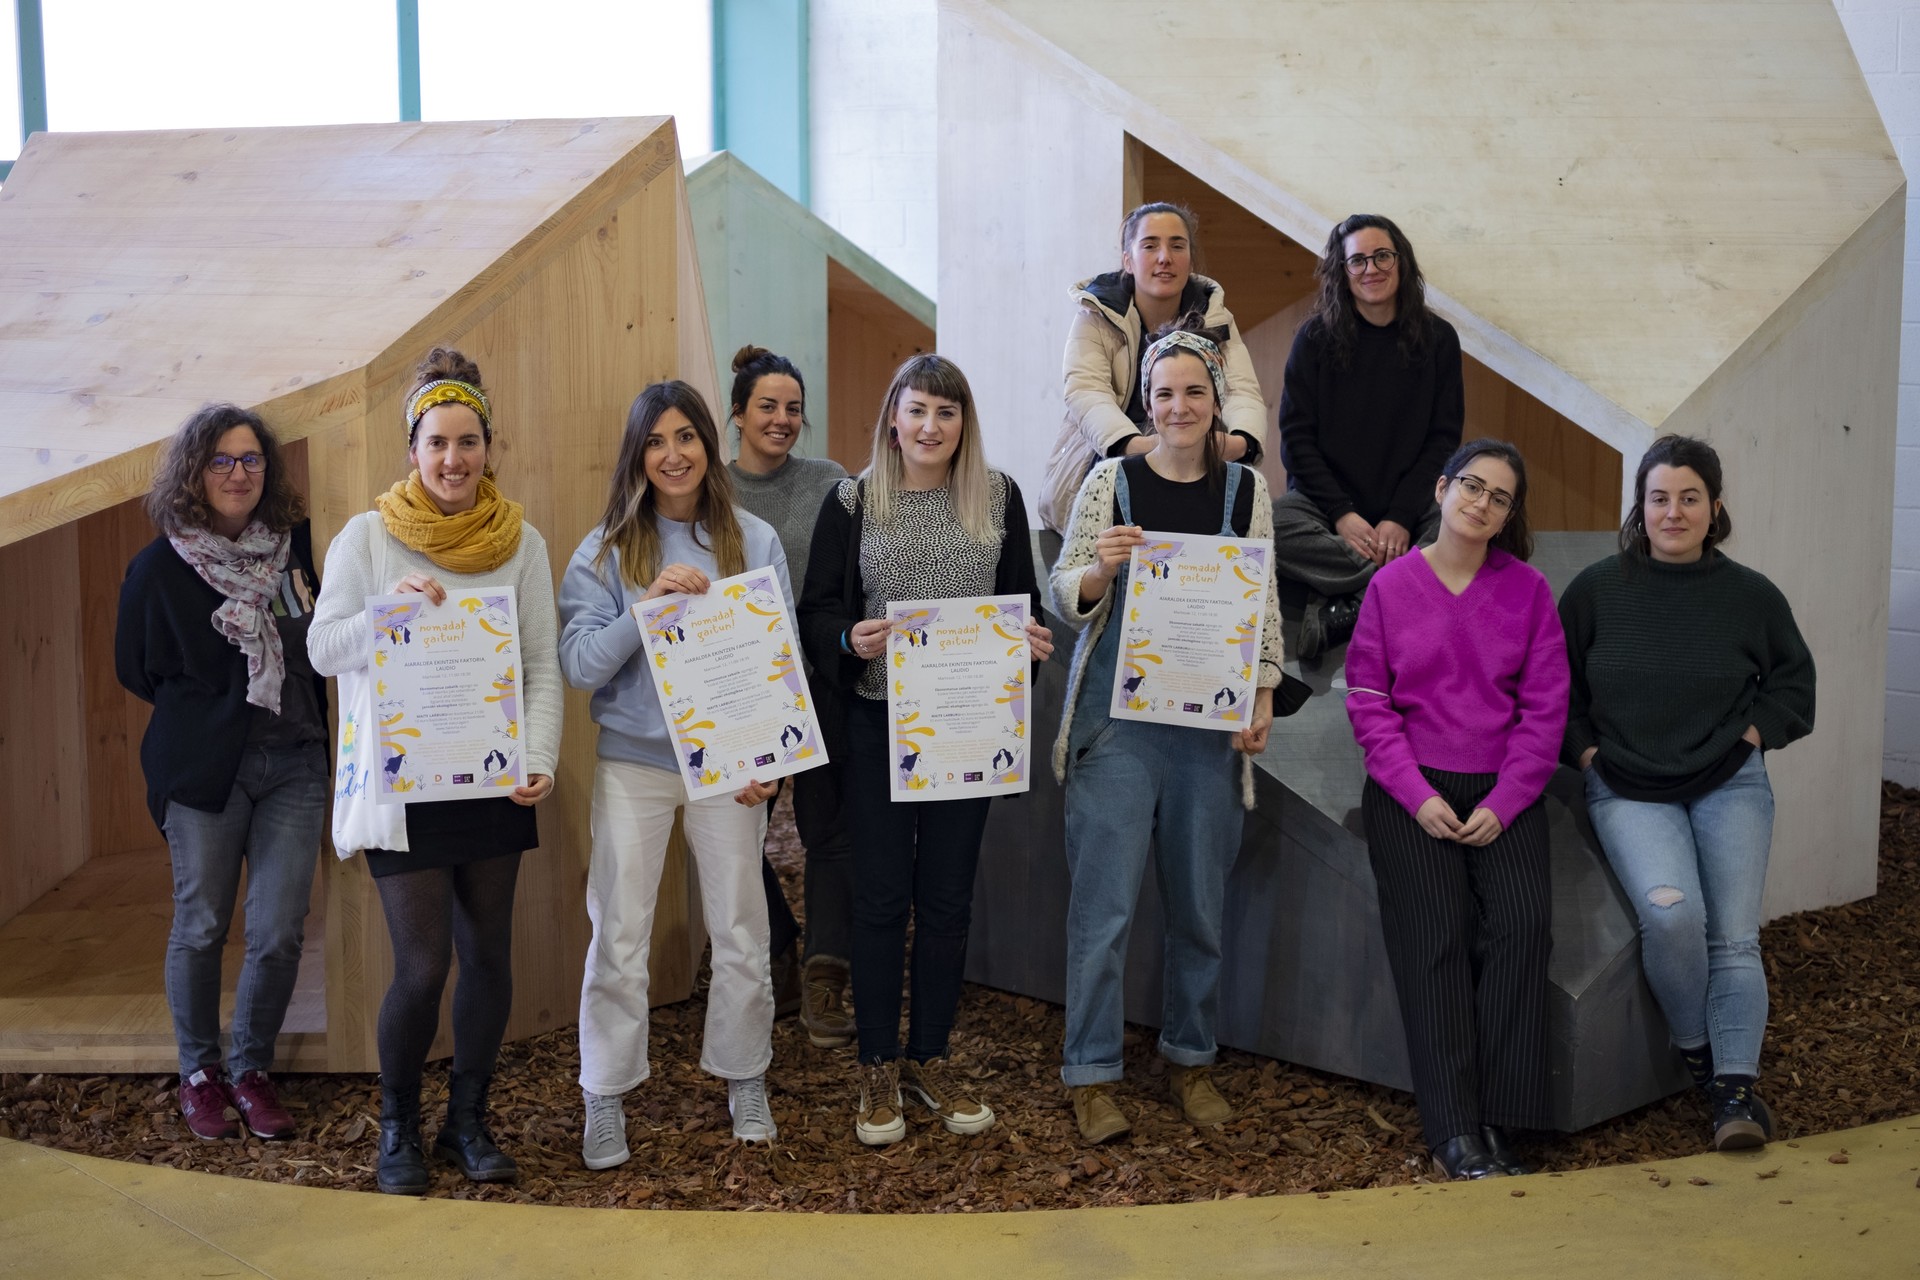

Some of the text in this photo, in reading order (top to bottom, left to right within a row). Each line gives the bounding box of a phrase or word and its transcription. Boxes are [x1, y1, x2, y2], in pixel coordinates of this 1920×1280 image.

[1177, 562, 1222, 573] nomadak
[1179, 573, 1218, 586] gaitun!
[690, 607, 737, 628] nomadak
[419, 618, 467, 632] nomadak
[697, 619, 735, 642] gaitun!
[936, 623, 982, 635] nomadak
[423, 631, 465, 648] gaitun!
[939, 636, 978, 650] gaitun!
